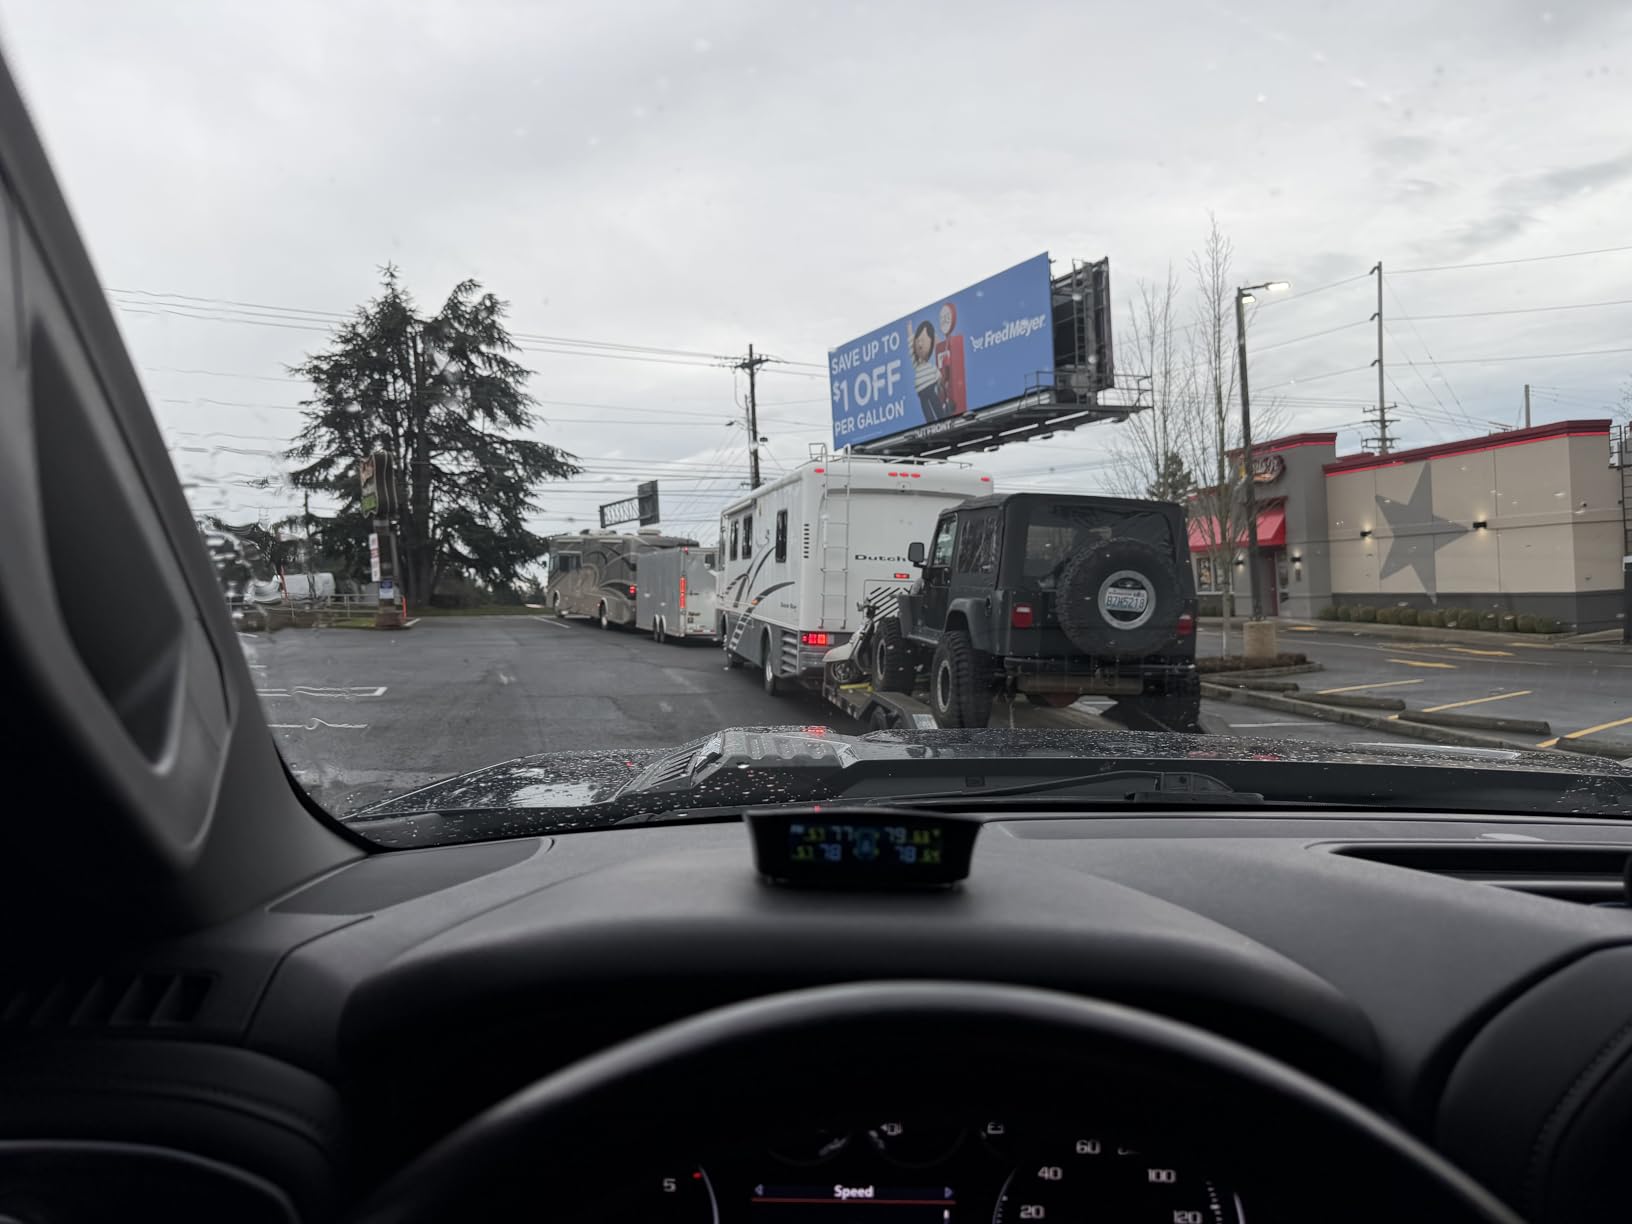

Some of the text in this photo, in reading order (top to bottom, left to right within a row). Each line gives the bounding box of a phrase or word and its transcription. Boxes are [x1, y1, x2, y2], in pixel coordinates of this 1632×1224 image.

[831, 331, 900, 375] SAVE UP TO
[832, 359, 901, 412] $1 OFF
[834, 417, 855, 437] PER
[1075, 1138, 1102, 1155] 60
[1037, 1166, 1063, 1181] 40
[1147, 1168, 1177, 1183] 100
[662, 1178, 677, 1193] 5
[833, 1184, 875, 1201] Speed
[1019, 1204, 1046, 1219] 20
[1172, 1209, 1203, 1224] 120
